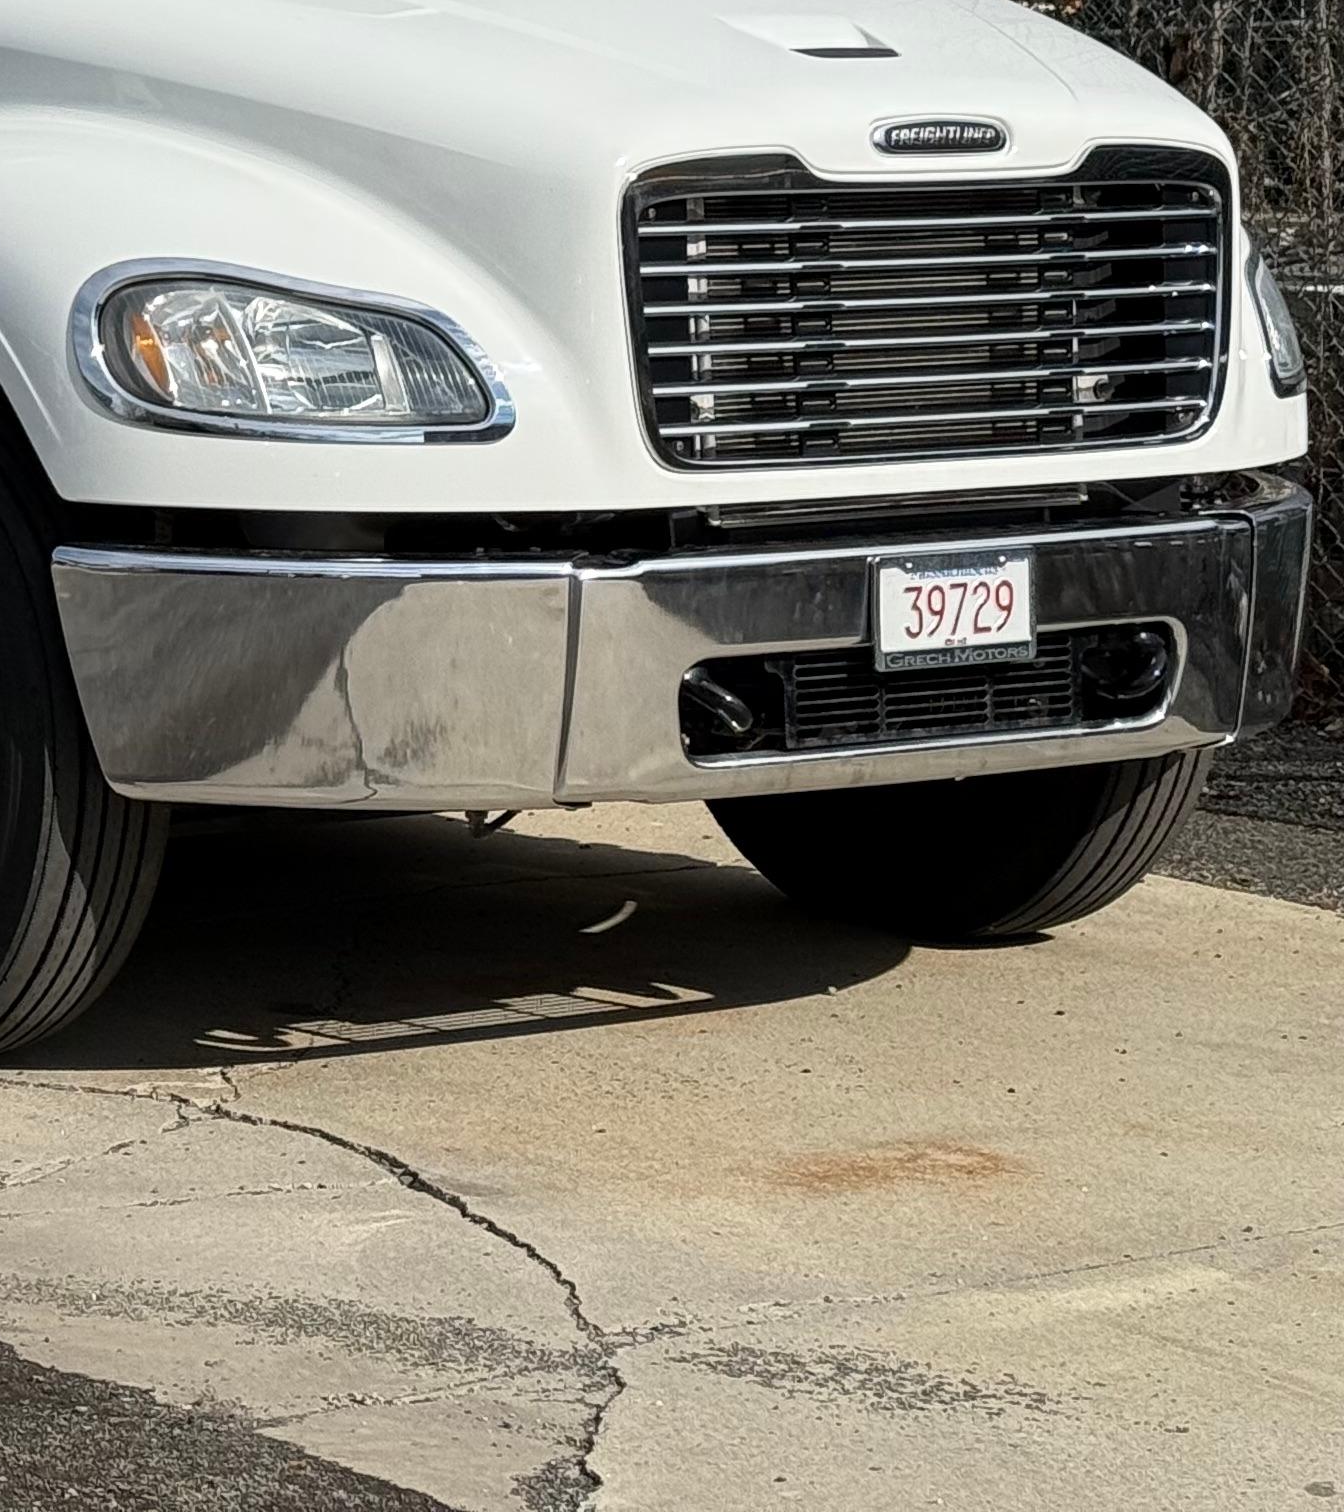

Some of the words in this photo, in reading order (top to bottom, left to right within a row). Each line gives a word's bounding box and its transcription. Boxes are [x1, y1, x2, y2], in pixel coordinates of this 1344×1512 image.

[904, 579, 1014, 639] 39729
[886, 652, 951, 668] GRECH
[954, 645, 1029, 664] MOTORS
